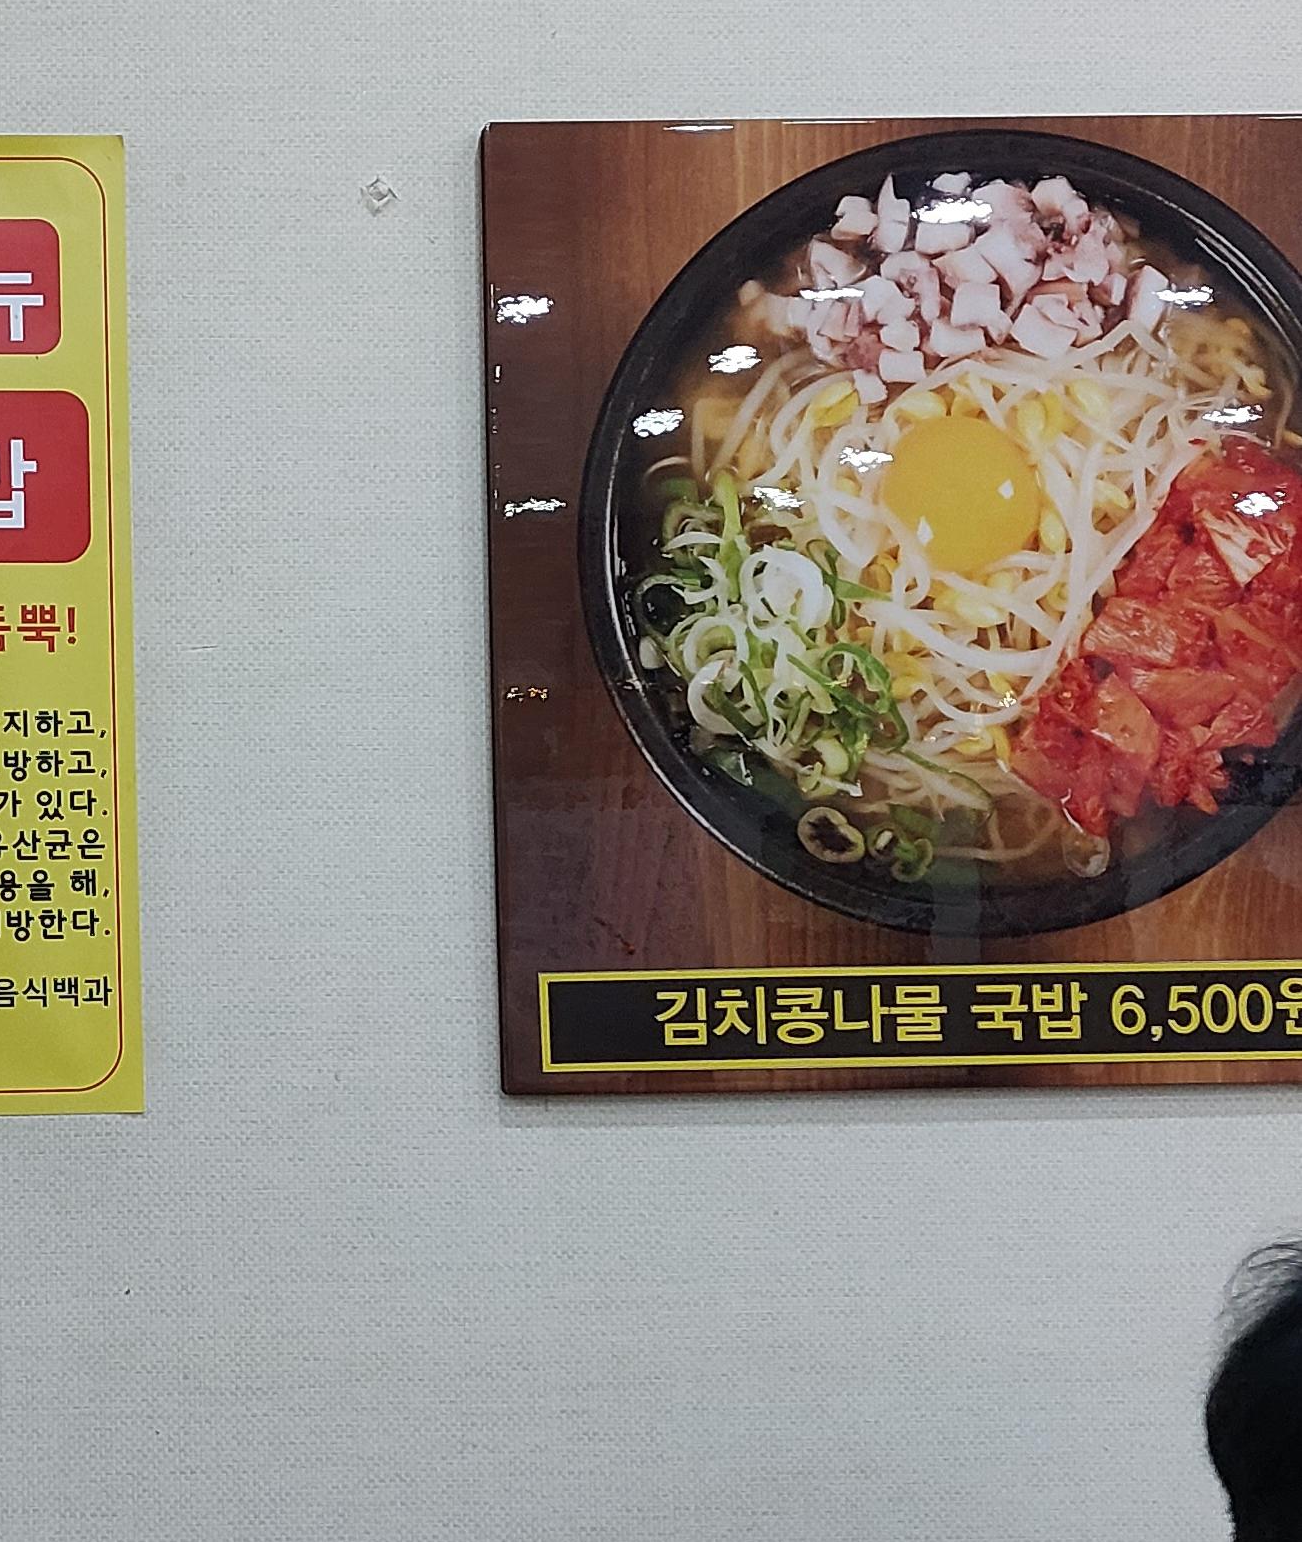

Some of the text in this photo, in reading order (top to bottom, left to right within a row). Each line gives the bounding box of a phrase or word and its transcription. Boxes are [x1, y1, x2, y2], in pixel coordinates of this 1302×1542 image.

[36, 789, 108, 821] 있다.
[69, 868, 110, 898] 해,
[654, 984, 948, 1046] 김치콩나물
[970, 981, 1088, 1041] 국밥
